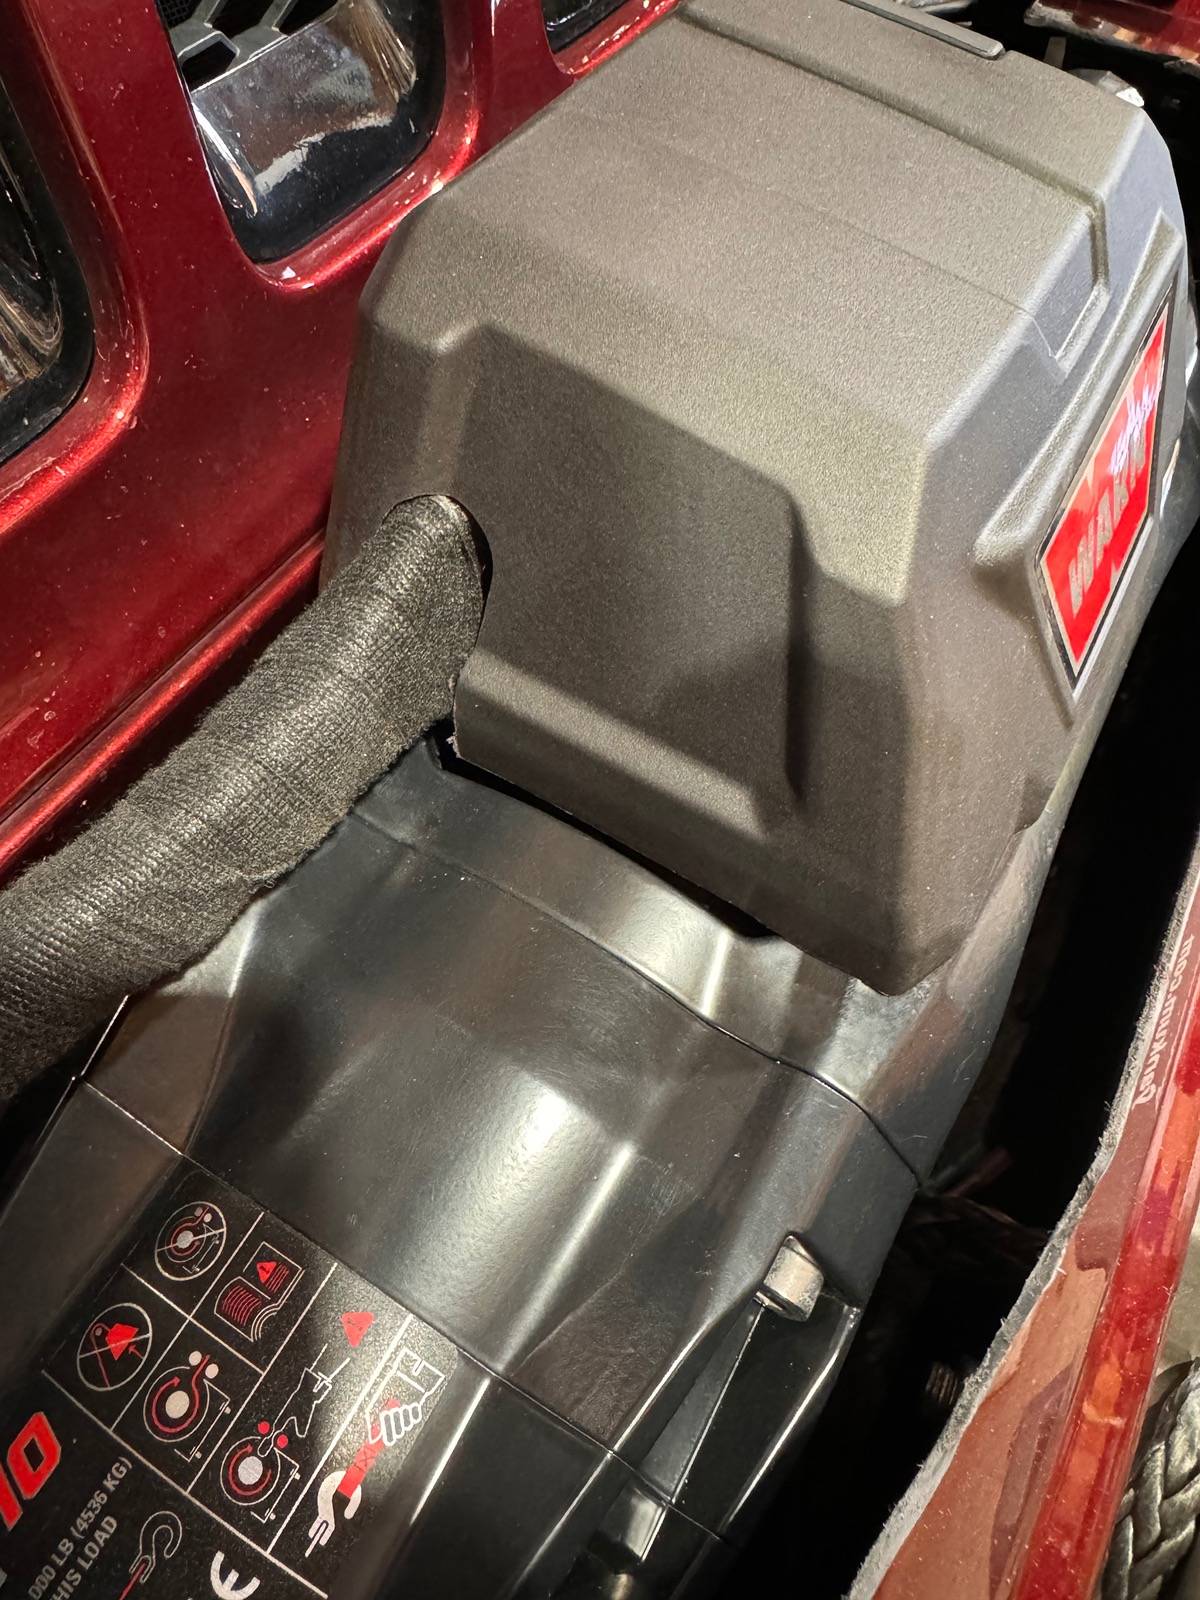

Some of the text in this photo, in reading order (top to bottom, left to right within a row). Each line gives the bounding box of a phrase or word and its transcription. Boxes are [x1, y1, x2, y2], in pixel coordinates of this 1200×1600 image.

[49, 1516, 117, 1600] HIS LOAD
[51, 1538, 74, 1566] LB
[70, 1490, 108, 1539] (4536
[103, 1457, 132, 1492] KG)
